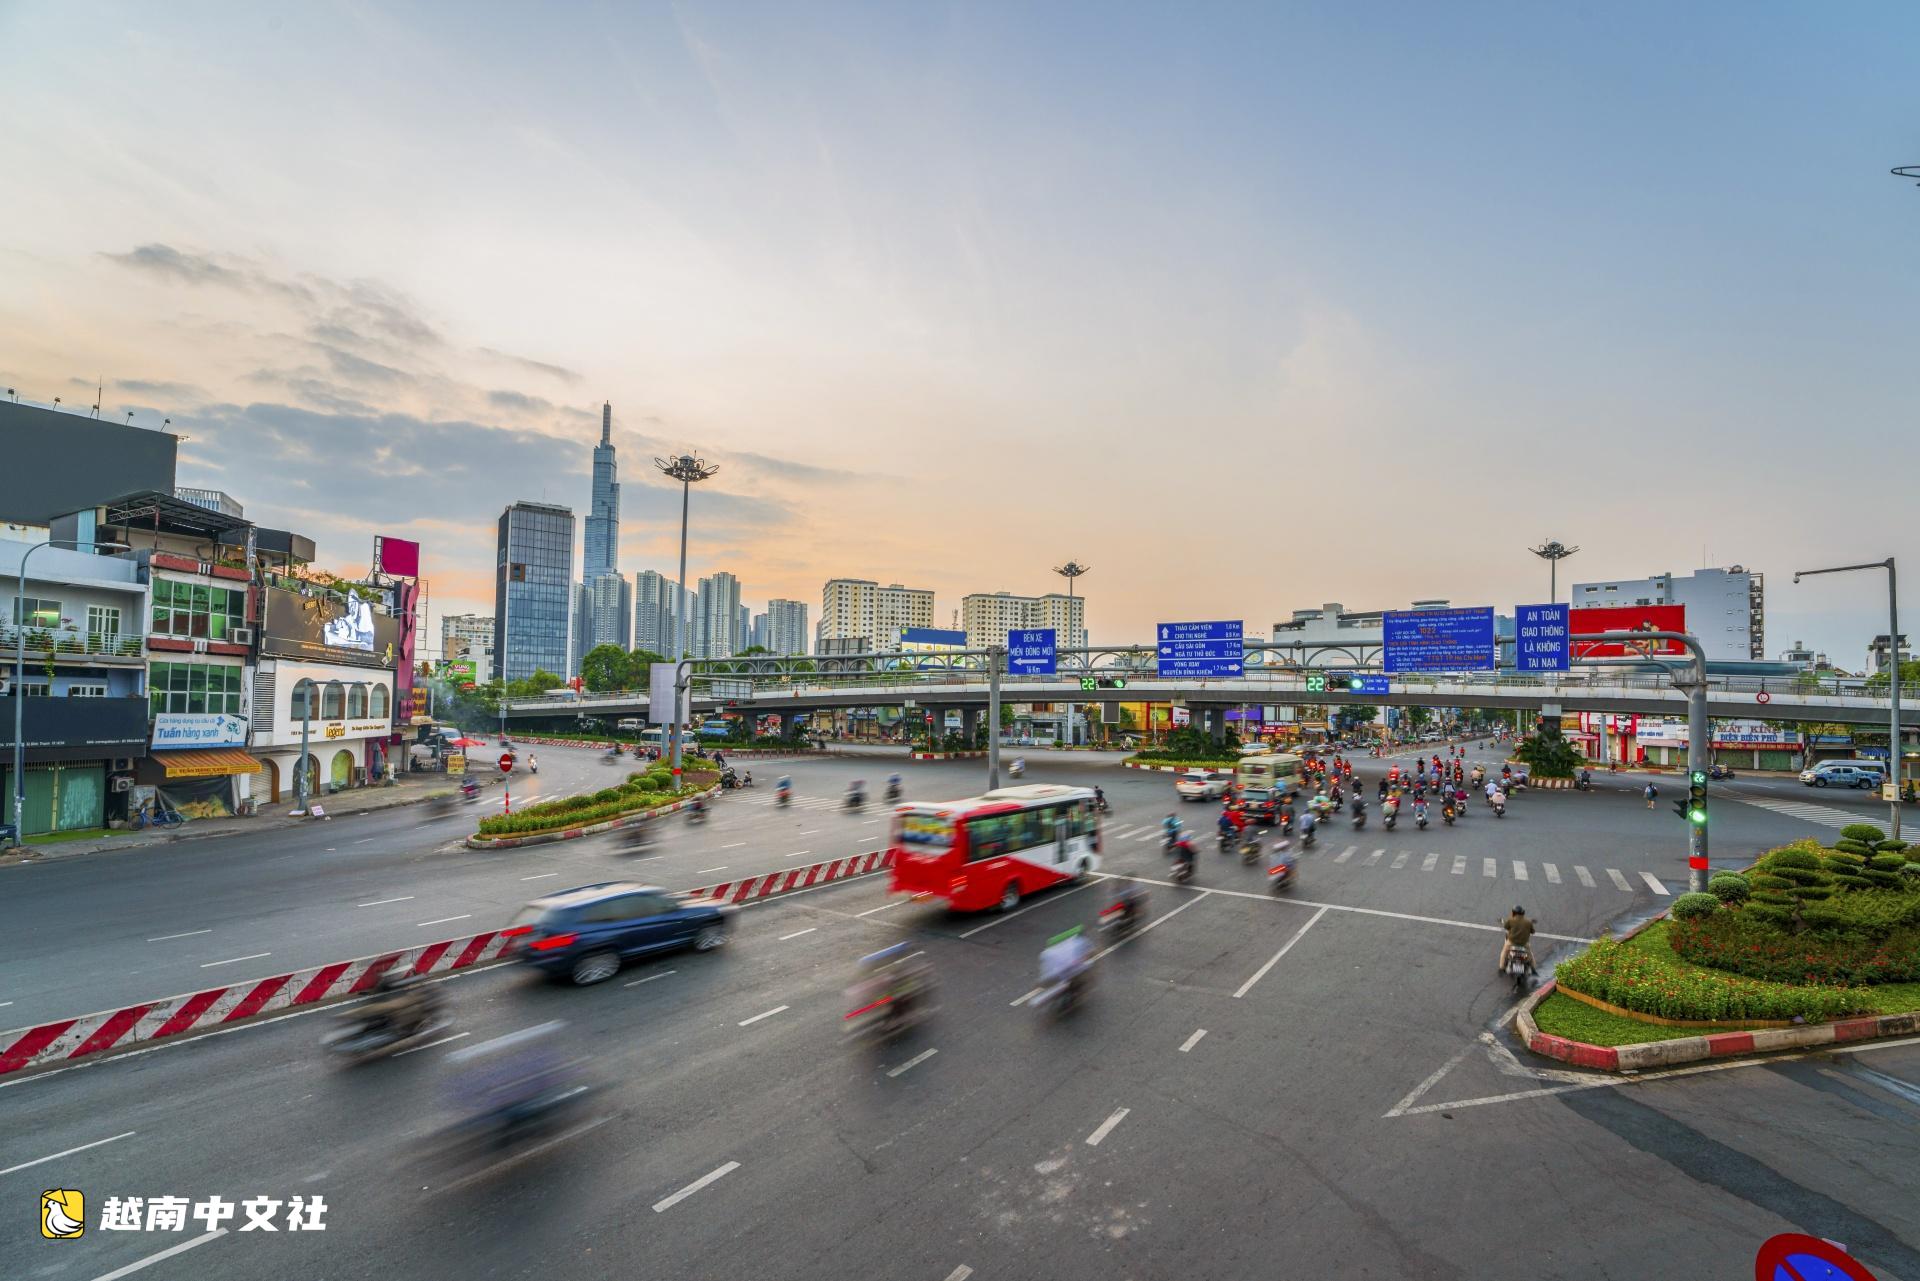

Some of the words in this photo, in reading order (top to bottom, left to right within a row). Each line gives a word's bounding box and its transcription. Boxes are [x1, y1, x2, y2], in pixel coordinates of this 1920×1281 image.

[1528, 611, 1538, 621] AN
[1541, 608, 1560, 621] TOÀN
[1024, 631, 1035, 643] BẾN
[1036, 633, 1043, 642] XE
[1521, 627, 1538, 637] GIAO
[1540, 625, 1564, 637] THÔNG
[1025, 645, 1041, 657] ĐÔNG
[1042, 643, 1054, 656] MỚI
[1525, 640, 1535, 653] LÀ
[1537, 640, 1561, 653] KHÔNG
[1032, 665, 1041, 674] Km
[1528, 658, 1539, 668] TAI
[1542, 657, 1557, 670] NẠN
[1082, 678, 1095, 690] 22
[1307, 677, 1325, 691] 22
[158, 727, 182, 738] Tuấn
[203, 727, 219, 738] xanh
[325, 725, 346, 739] Legend
[1741, 732, 1759, 742] BIÊN
[1761, 732, 1778, 742] PHỦ
[1695, 772, 1705, 783] 22
